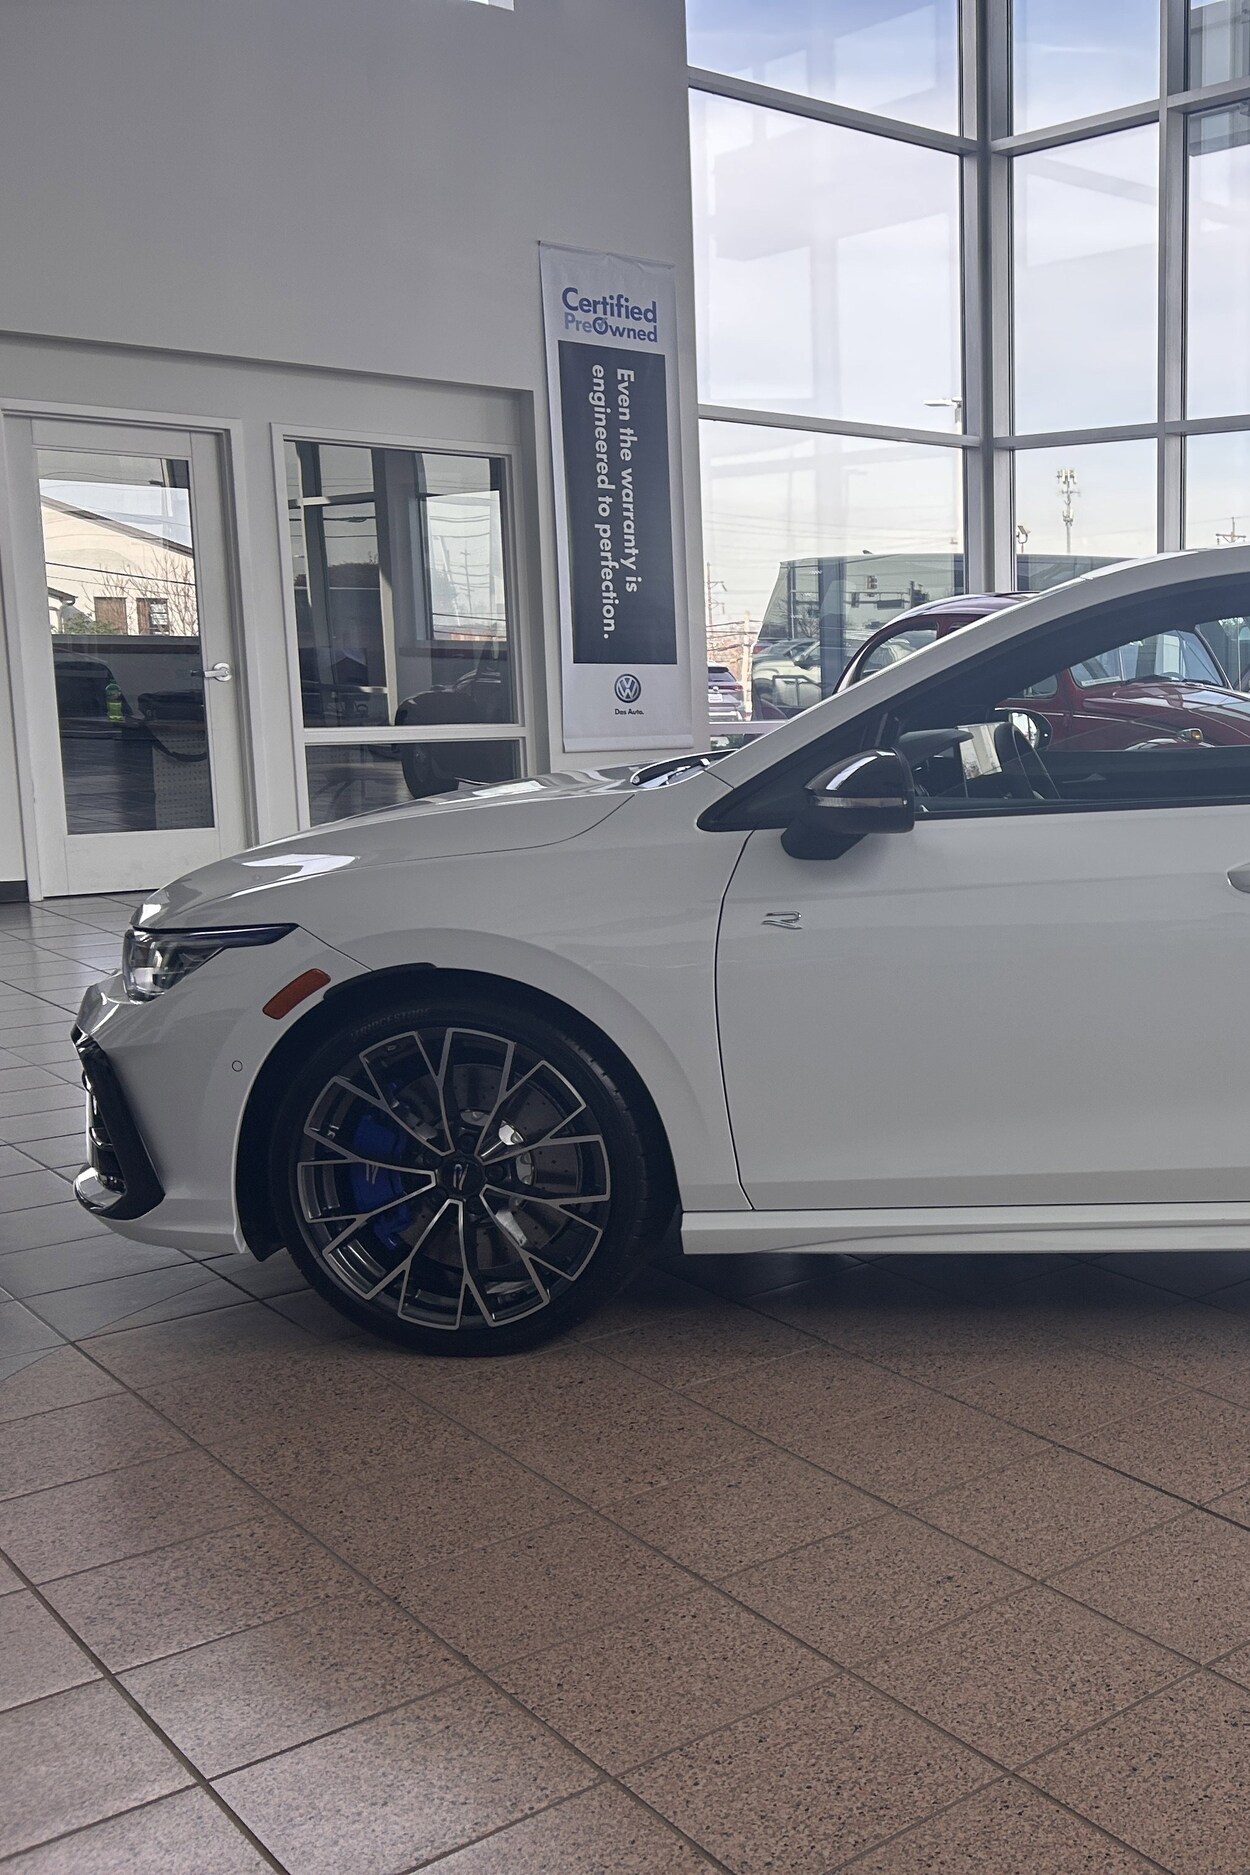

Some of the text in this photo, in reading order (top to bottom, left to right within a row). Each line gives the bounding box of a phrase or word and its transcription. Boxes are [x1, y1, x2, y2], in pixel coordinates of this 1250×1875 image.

[561, 286, 657, 324] Certified
[588, 364, 620, 639] engineered to perfection.
[616, 367, 642, 592] Even the warranty is
